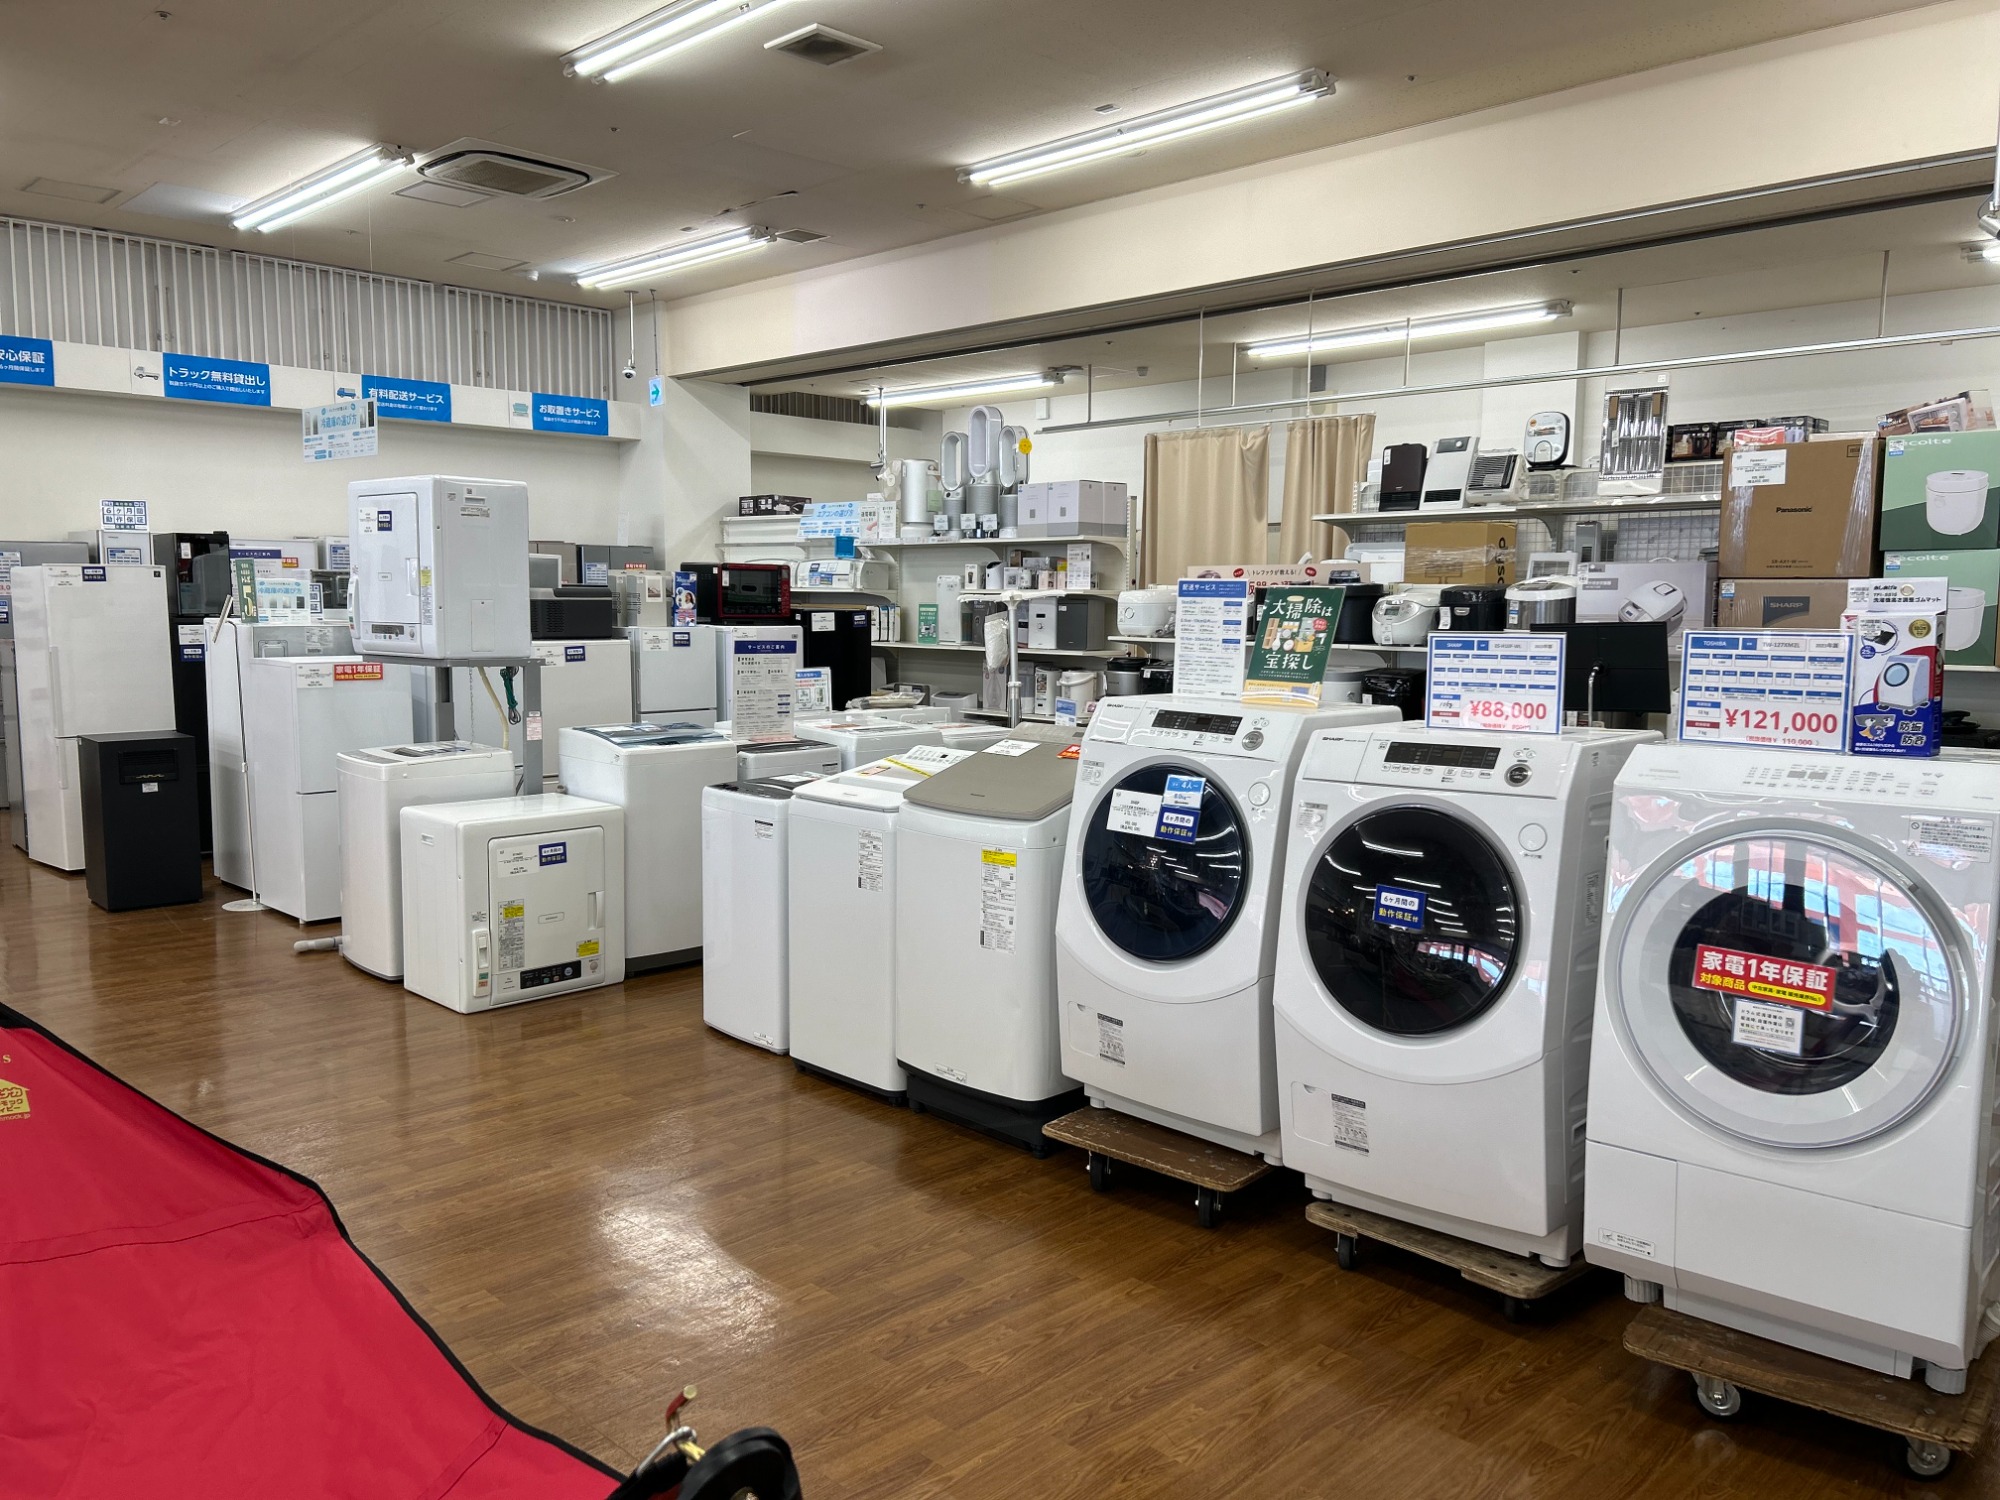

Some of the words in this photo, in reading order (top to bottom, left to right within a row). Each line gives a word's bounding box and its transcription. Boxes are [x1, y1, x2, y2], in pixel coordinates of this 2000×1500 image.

[169, 366, 266, 386] トラック無料貸出し
[368, 388, 444, 404] 有料配送サービス
[539, 404, 601, 419] お取置きサービス
[1182, 583, 1216, 592] 配送サービス
[1270, 598, 1333, 620] 大掃除は
[1264, 652, 1314, 670] 宝探し
[335, 665, 382, 674] 家電1年保証
[1469, 700, 1547, 720] ¥88,000
[1724, 708, 1839, 734] ¥121,000
[1898, 721, 1924, 733] 防振
[1900, 735, 1927, 746] 防音
[1383, 894, 1416, 908] 6ヶ月間の
[1378, 907, 1419, 923] 動作保証付
[1702, 950, 1829, 991] 家電1年保証
[1700, 972, 1745, 990] 対象商品
